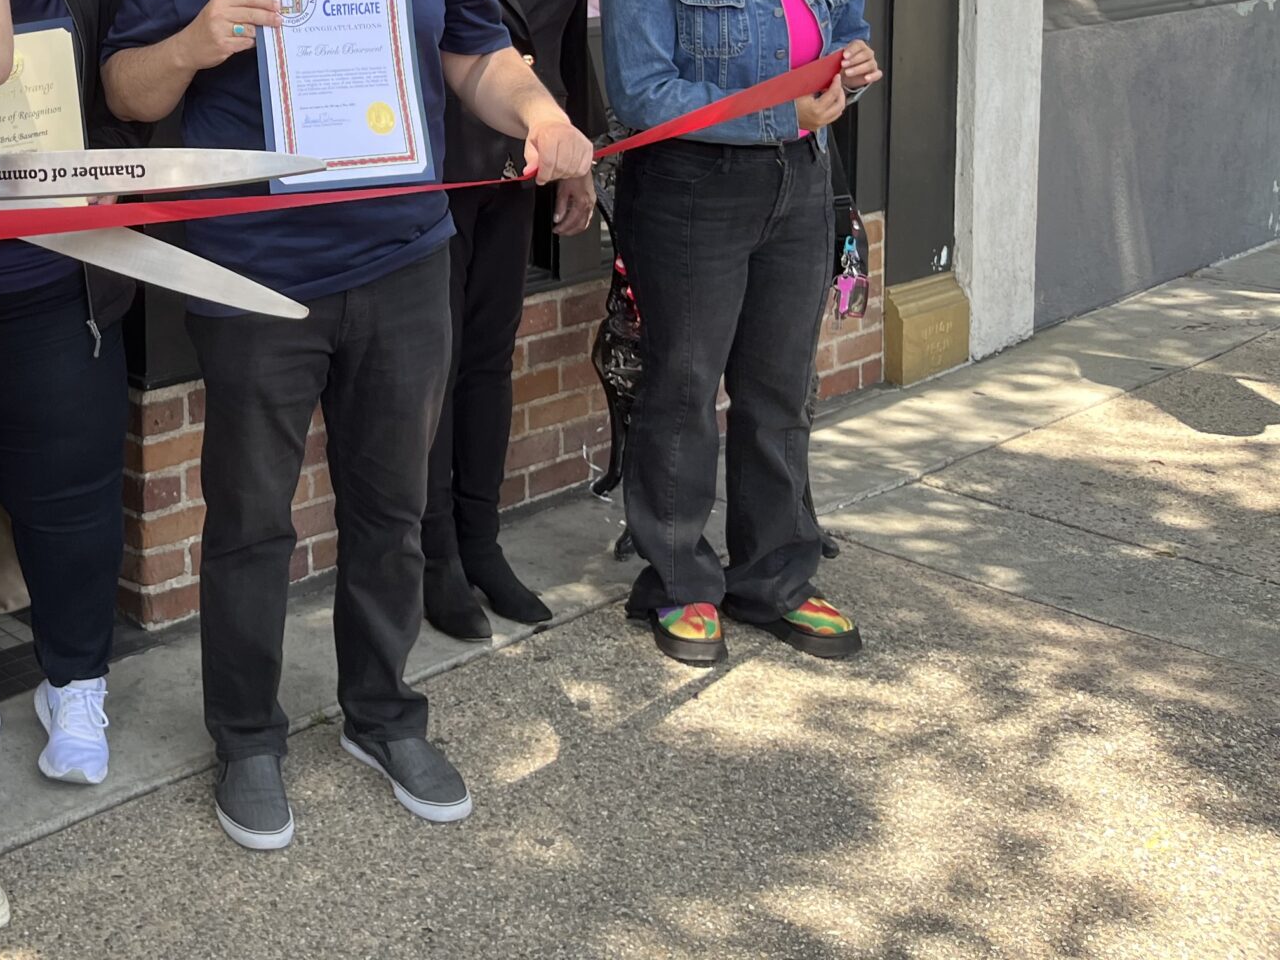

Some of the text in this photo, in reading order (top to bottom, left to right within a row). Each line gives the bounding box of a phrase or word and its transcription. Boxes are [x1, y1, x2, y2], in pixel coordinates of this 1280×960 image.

[322, 0, 380, 16] CERTIFICATE
[304, 24, 382, 33] CONGRATULATIONS
[296, 45, 313, 57] The
[7, 111, 17, 124] of
[18, 105, 62, 120] Recognition
[0, 133, 17, 143] Brick
[18, 129, 48, 140] Basement
[52, 168, 67, 182] of
[72, 164, 146, 180] Chamber
